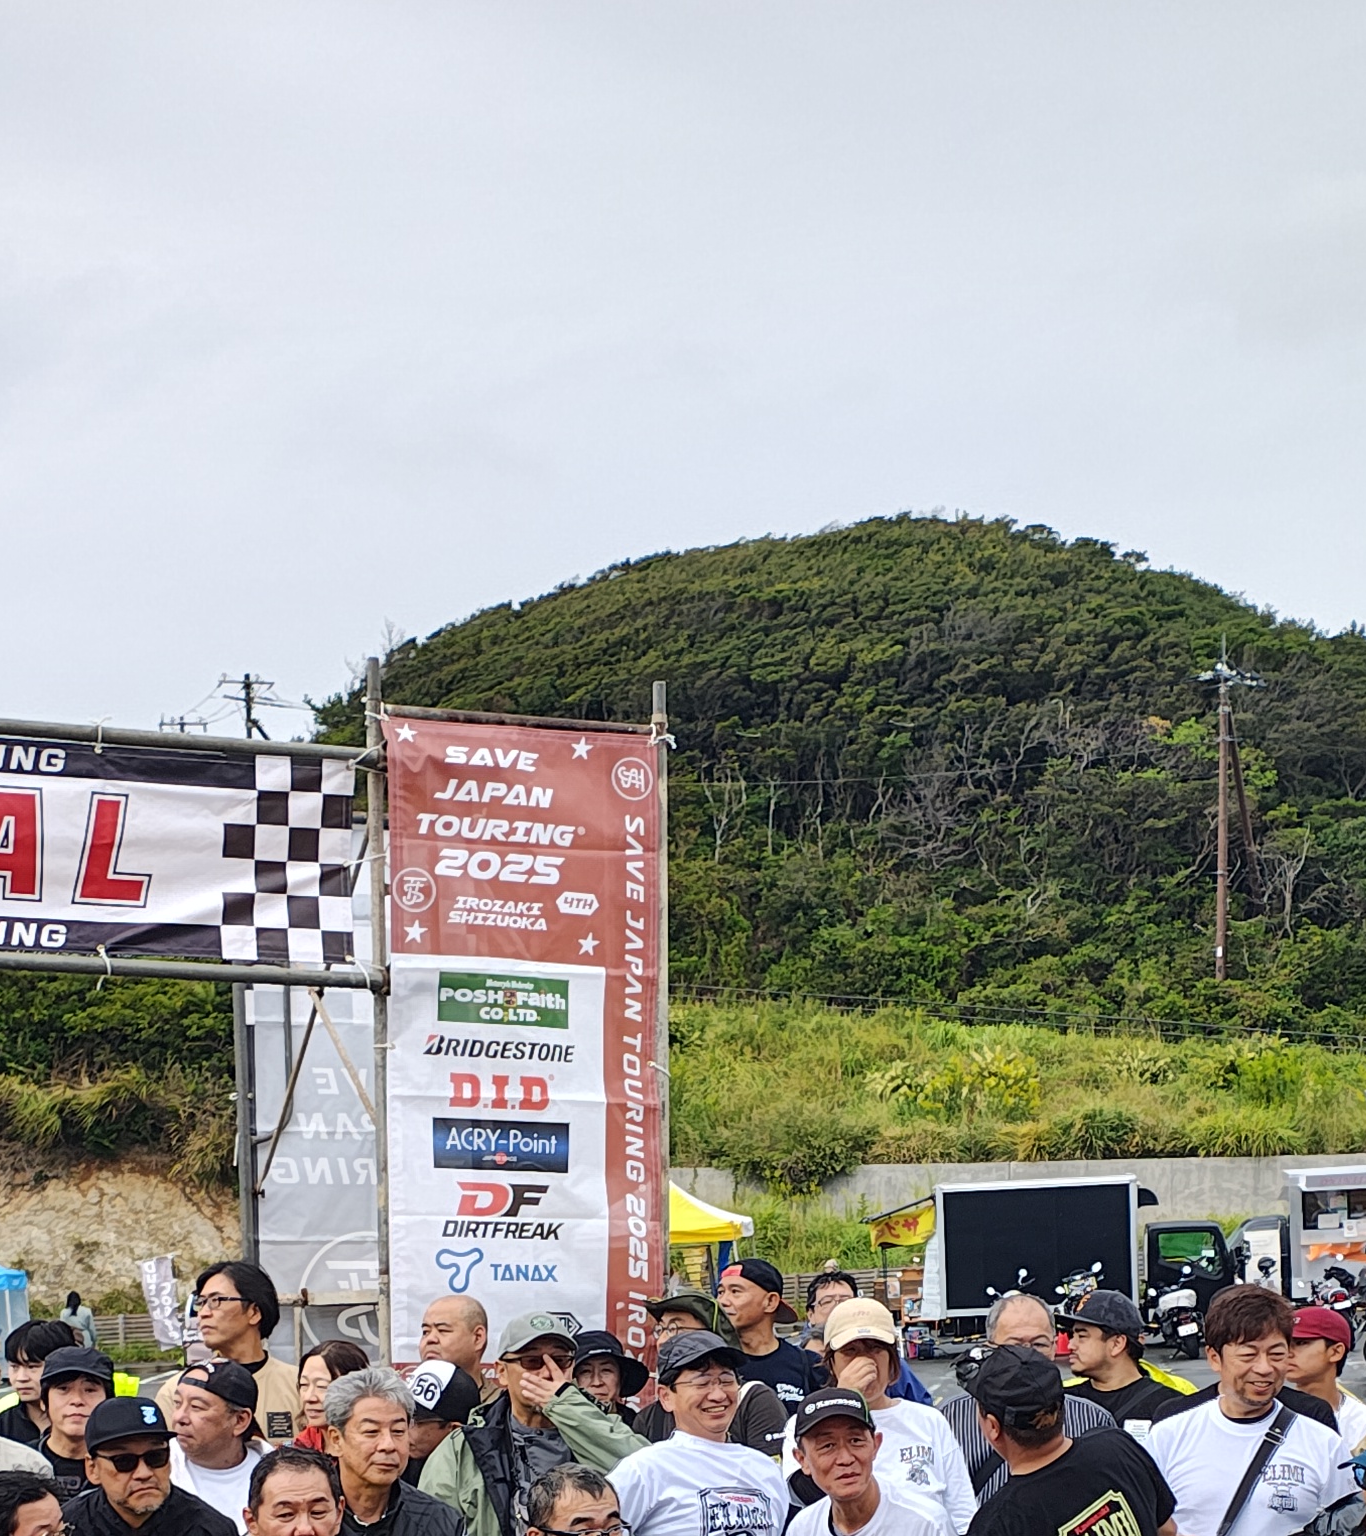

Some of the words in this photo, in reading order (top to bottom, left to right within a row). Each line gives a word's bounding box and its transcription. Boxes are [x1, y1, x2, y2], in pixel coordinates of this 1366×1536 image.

[444, 745, 540, 773] SAVE
[433, 778, 554, 809] JAPAN
[415, 813, 576, 848] TOURING
[434, 848, 566, 885] 2025
[624, 814, 645, 903] SAVE
[453, 895, 544, 916] IROZAKI
[562, 896, 595, 912] 4TH
[446, 910, 548, 932] SHIZUOKA
[623, 910, 645, 1022] JAPAN
[439, 987, 505, 1005] POSH
[515, 989, 566, 1010] Faith
[423, 1035, 576, 1064] BRIDGESTONE
[449, 1072, 551, 1111] D.I.D
[622, 1032, 646, 1186] TOURING
[445, 1127, 558, 1155] ACRY-Point
[456, 1181, 550, 1217] DF
[441, 1219, 566, 1241] DIRTFREAK
[624, 1189, 649, 1284] 2025
[489, 1262, 559, 1284] TANAX
[412, 1377, 437, 1402] 56
